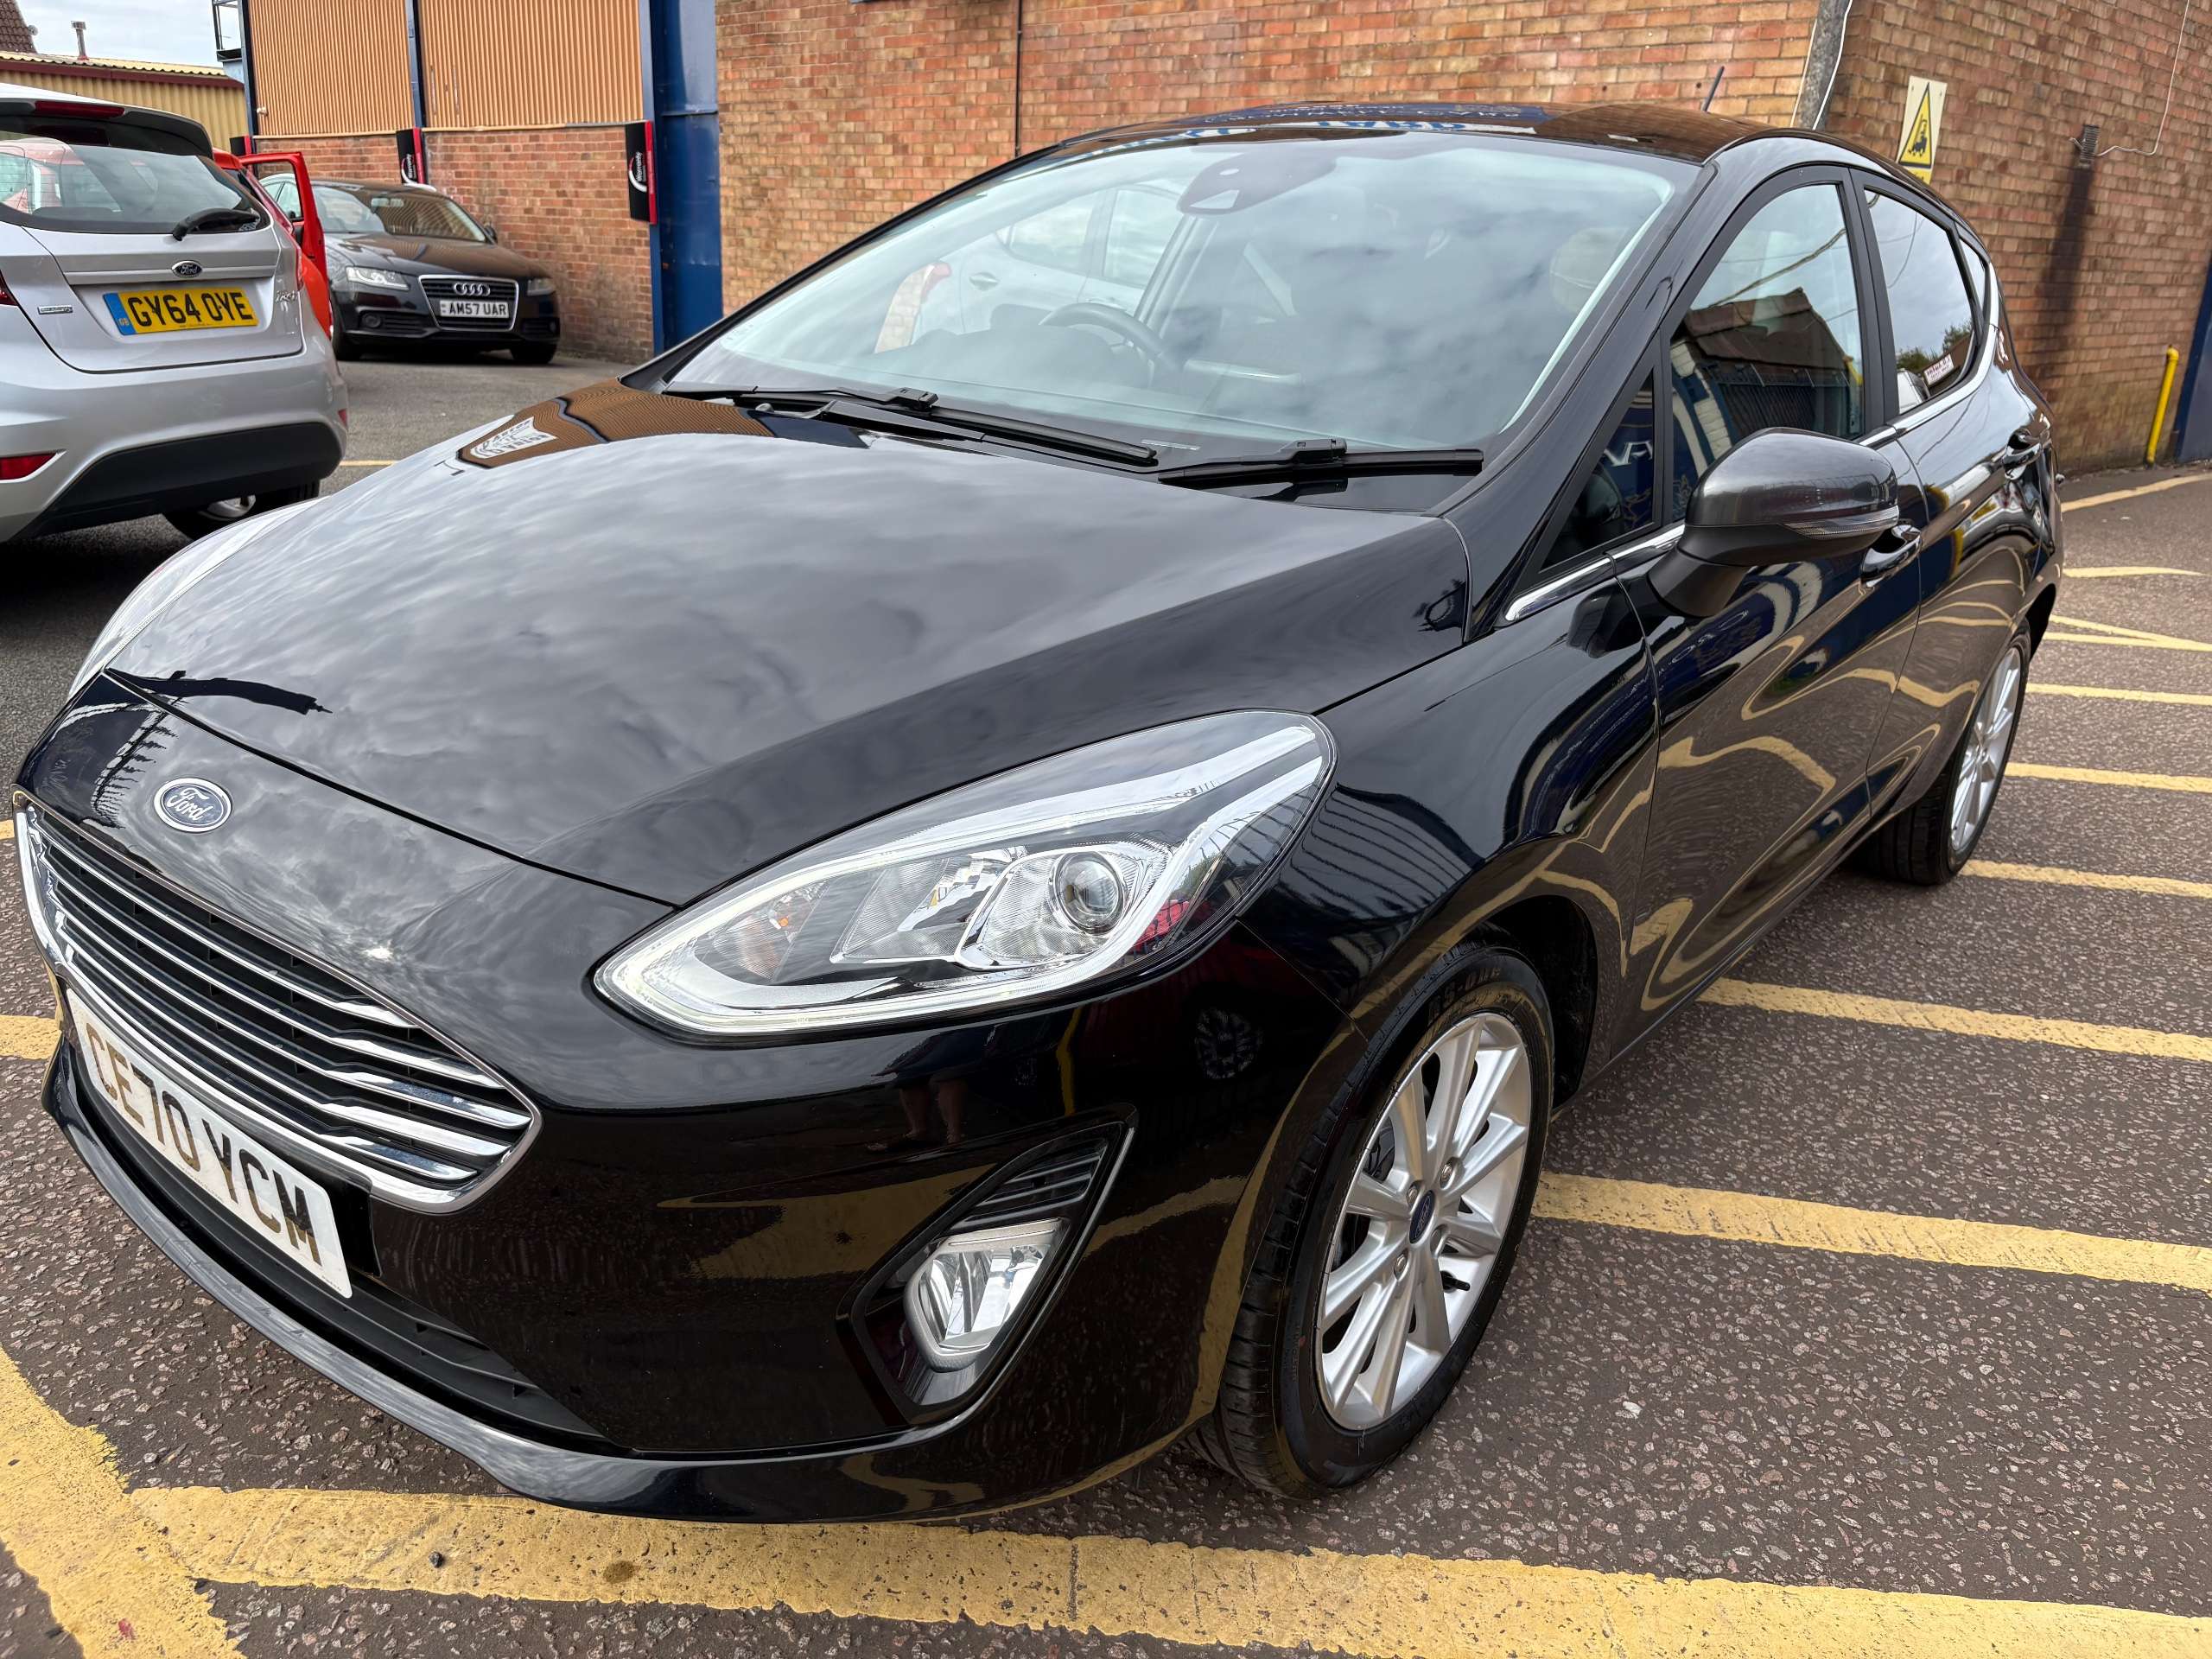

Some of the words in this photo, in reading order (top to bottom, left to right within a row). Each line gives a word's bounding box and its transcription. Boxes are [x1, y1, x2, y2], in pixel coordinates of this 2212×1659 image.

[127, 293, 202, 327] GY64
[200, 291, 253, 321] OYE
[449, 300, 480, 315] AM57
[483, 301, 507, 316] UAR
[166, 787, 214, 821] Ford
[86, 1022, 201, 1173] CE70
[201, 1118, 323, 1268] YCM
